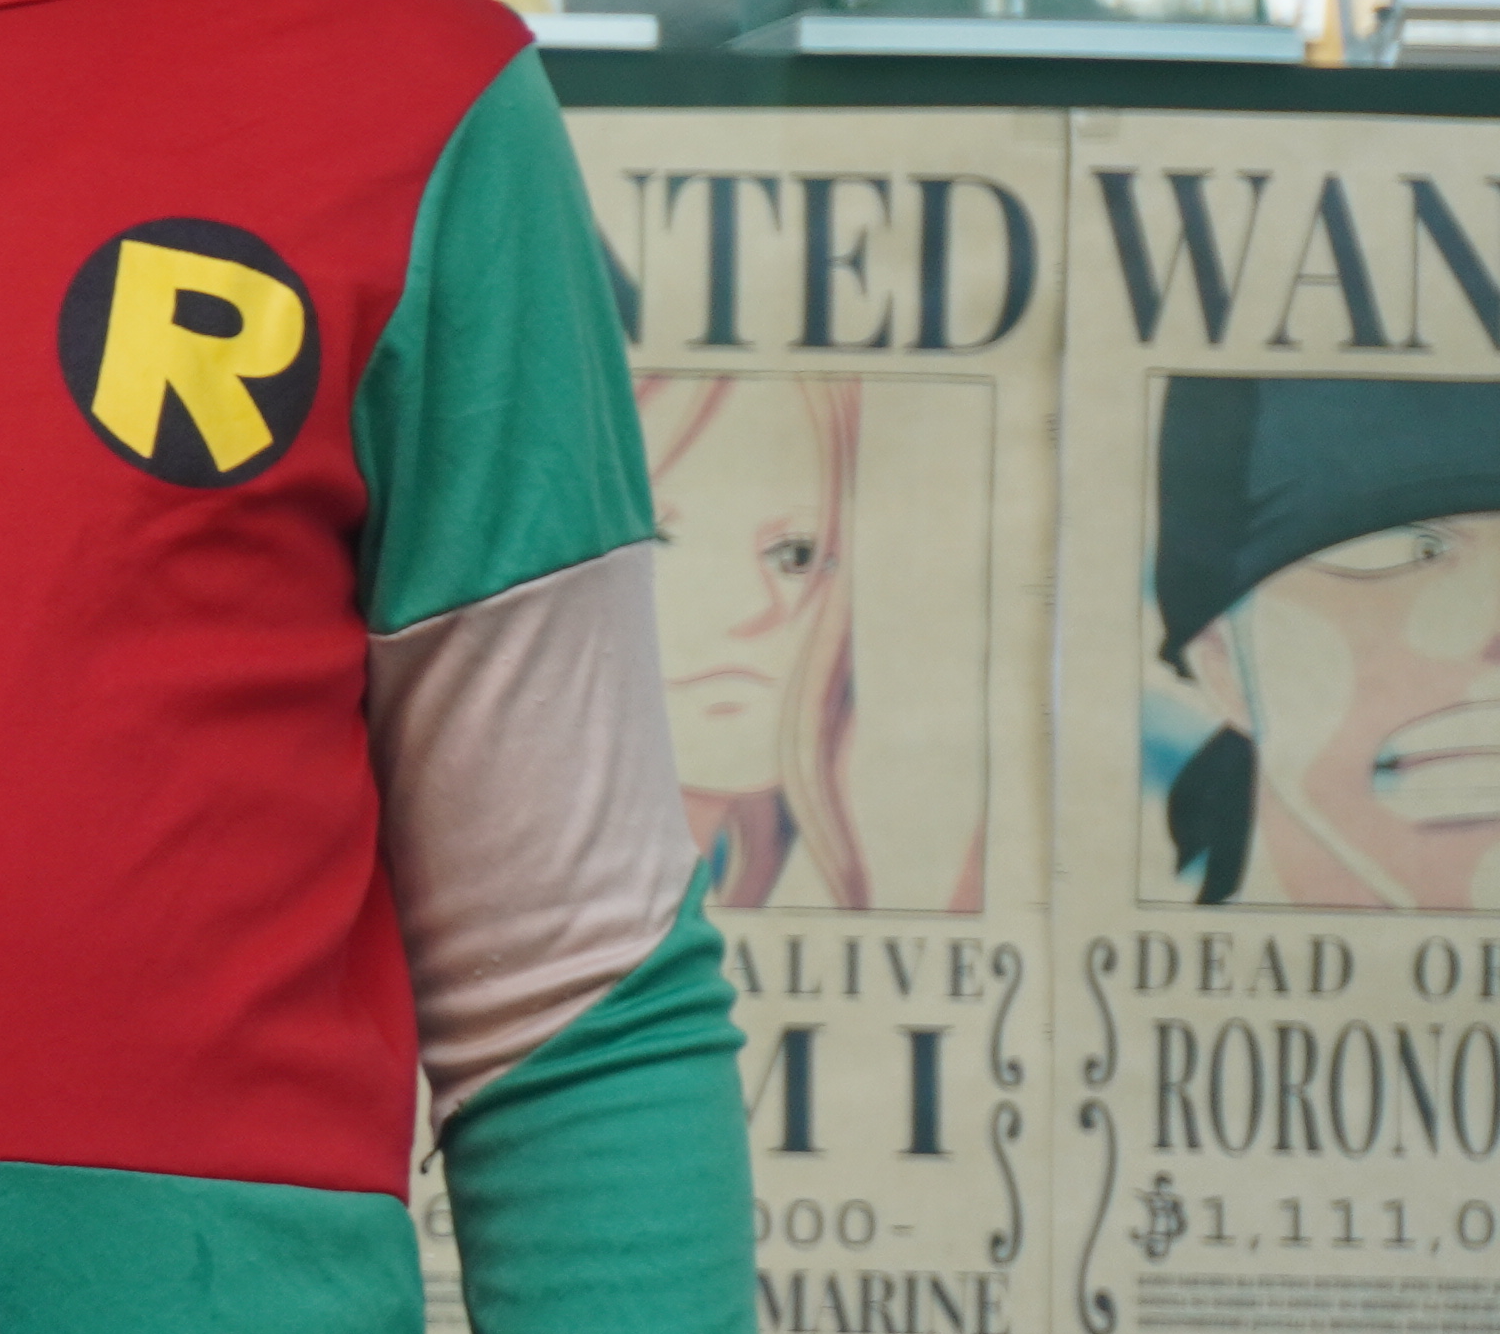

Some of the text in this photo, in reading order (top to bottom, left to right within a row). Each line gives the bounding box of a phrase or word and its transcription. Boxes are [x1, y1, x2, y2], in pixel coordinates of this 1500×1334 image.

[91, 239, 304, 473] R
[732, 934, 985, 1000] ALIVE
[1131, 930, 1356, 996] DEAD
